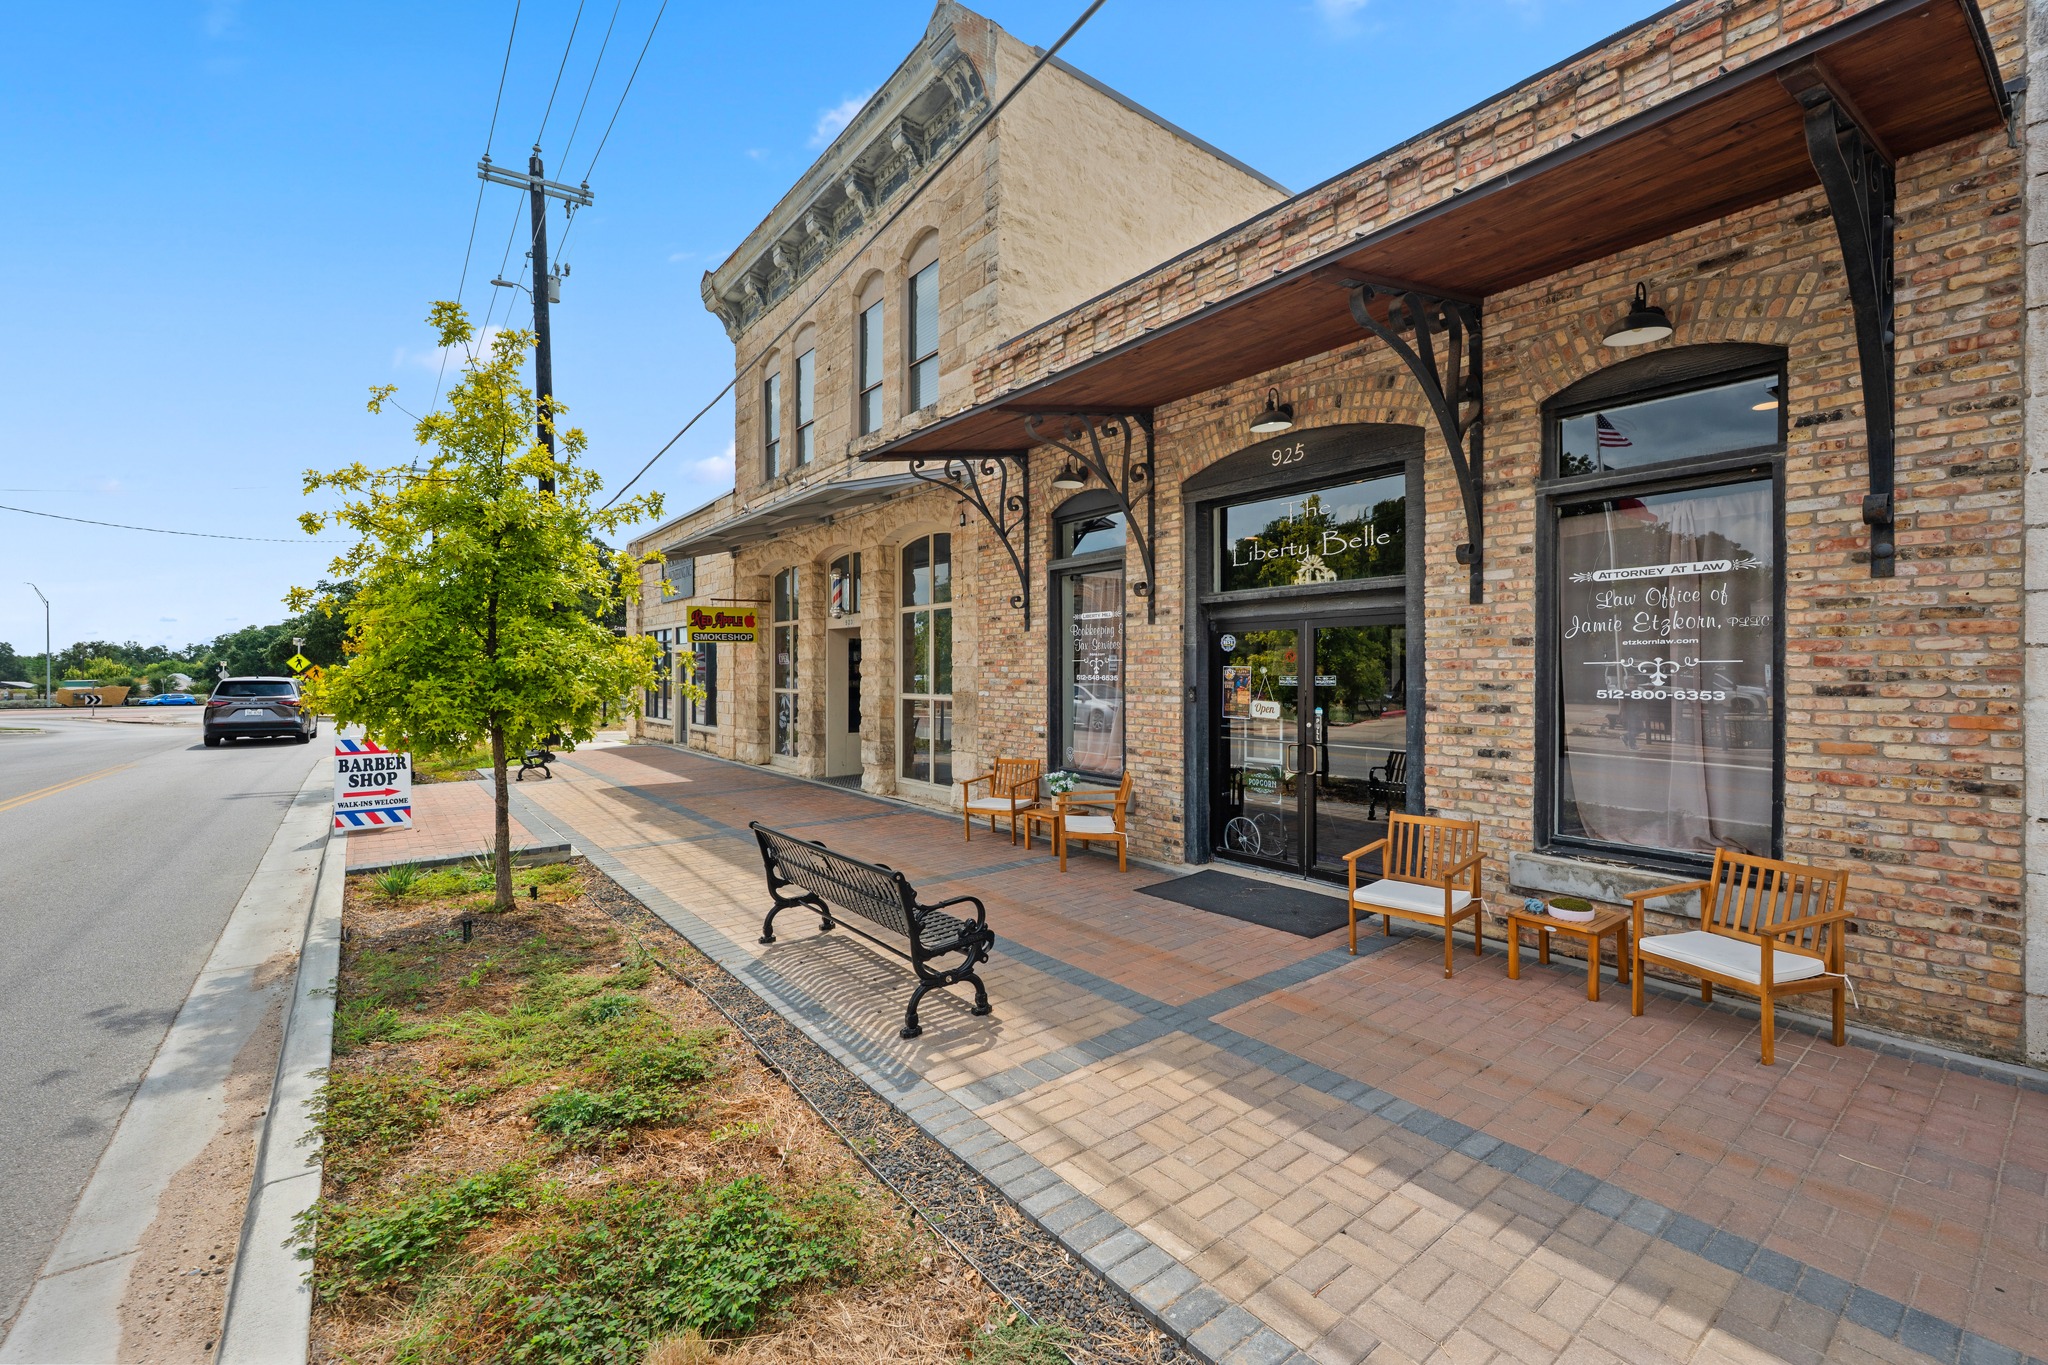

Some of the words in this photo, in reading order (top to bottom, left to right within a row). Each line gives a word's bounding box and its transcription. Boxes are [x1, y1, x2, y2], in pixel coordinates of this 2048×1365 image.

[1271, 443, 1305, 466] 925
[1281, 499, 1331, 524] The
[1233, 541, 1309, 567] Liberty
[1322, 525, 1391, 556] Belle
[1599, 568, 1665, 580] ATTORNEY
[1671, 566, 1687, 574] AT
[1693, 563, 1725, 572] LAW
[1596, 589, 1636, 609] Law
[1645, 587, 1701, 609] Office
[1711, 583, 1728, 606] of
[1070, 623, 1115, 638] Bookkeeping
[1565, 616, 1622, 639] Jamie
[1633, 611, 1722, 636] Etzkorn,
[1727, 616, 1770, 627] PLLC
[693, 633, 753, 642] SMOKESHOP
[1074, 639, 1088, 652] Tax
[1091, 638, 1121, 651] Services
[1622, 637, 1699, 646] etzkornlaw.com
[1596, 689, 1726, 701] 512-800-6353
[1254, 702, 1275, 714] Open
[338, 757, 407, 773] BARBER
[348, 772, 398, 788] SHOP
[1248, 778, 1277, 788] POPCORN
